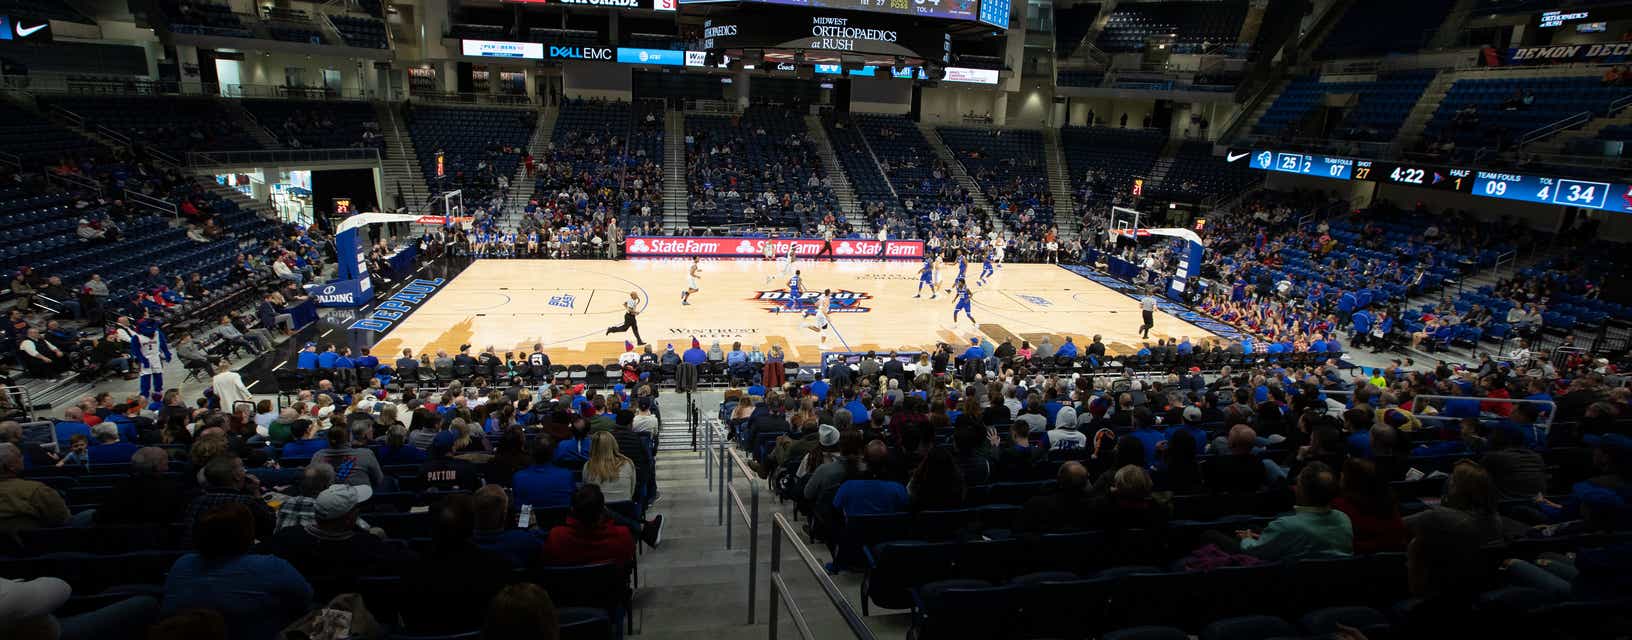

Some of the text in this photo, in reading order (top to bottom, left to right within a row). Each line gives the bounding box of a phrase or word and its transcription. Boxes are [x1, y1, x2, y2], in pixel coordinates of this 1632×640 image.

[813, 17, 848, 26] MIDWEST
[812, 25, 897, 42] ORTHOPAEDICS
[811, 39, 854, 51] at RUSH
[1512, 46, 1581, 60] DEMON
[1282, 156, 1297, 169] 25
[1303, 161, 1311, 172] 2
[1357, 160, 1372, 168] SHOT
[1330, 165, 1344, 176] 07
[1356, 168, 1370, 179] 27
[1390, 167, 1424, 184] 4:22
[1450, 169, 1470, 178] HALF
[1478, 171, 1521, 182] TEAM FOULS
[1454, 178, 1462, 190] 1
[1539, 177, 1553, 185] TOL
[1486, 181, 1507, 195] 09
[1537, 186, 1549, 200] 4
[1566, 185, 1594, 203] 34
[347, 277, 446, 332] DEPAUL
[427, 470, 457, 481] PAYTON
